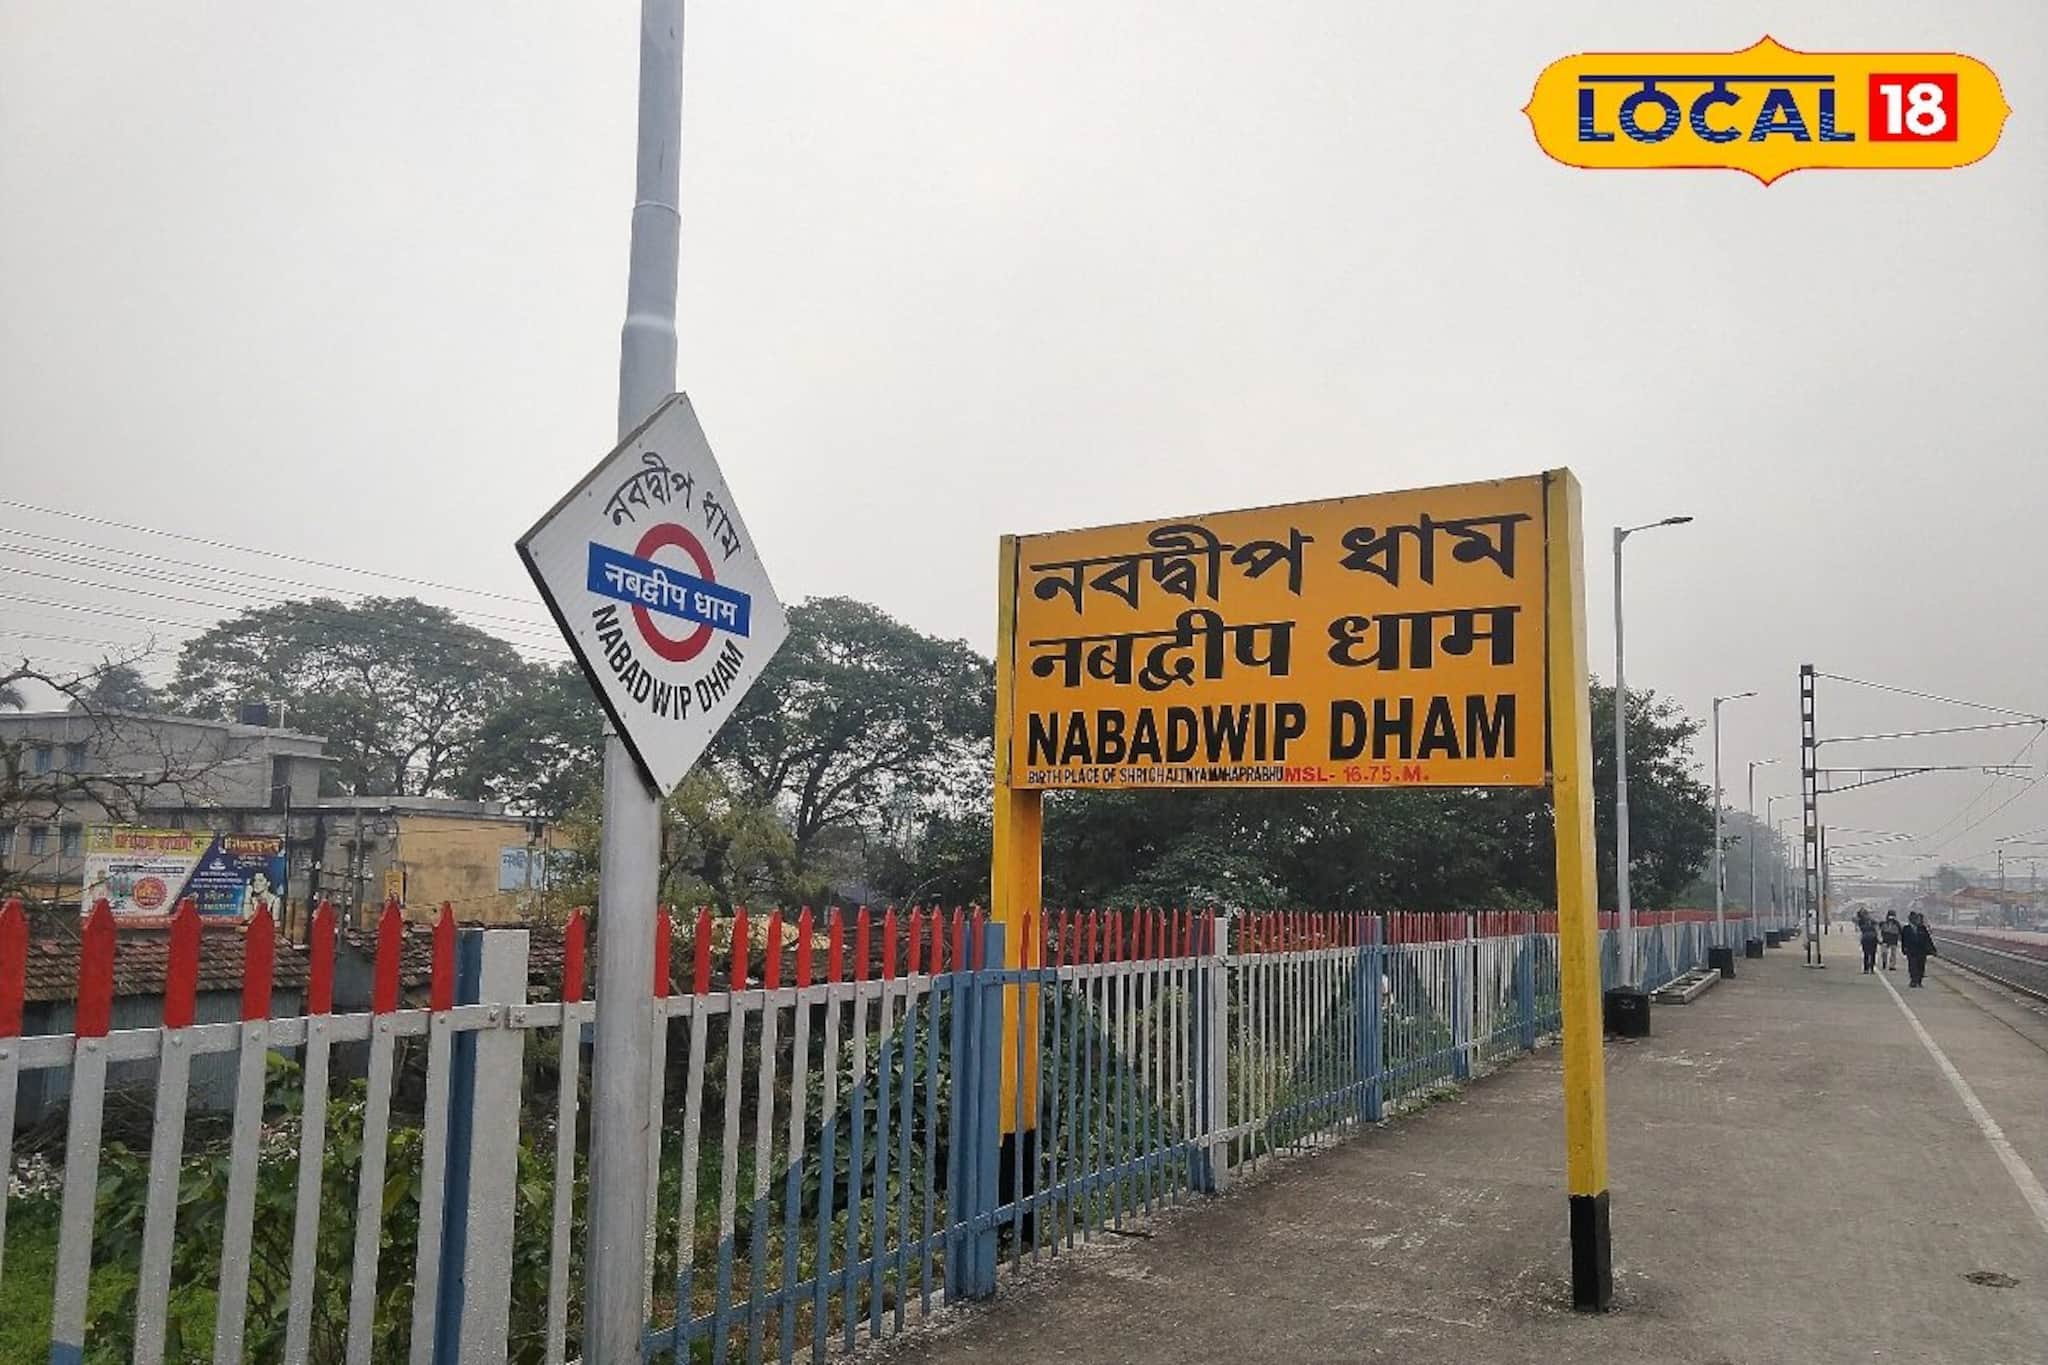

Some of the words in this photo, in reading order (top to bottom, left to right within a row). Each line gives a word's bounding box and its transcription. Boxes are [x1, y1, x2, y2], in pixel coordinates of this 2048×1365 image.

[604, 452, 694, 527] নবদ্বীপ
[703, 490, 741, 561] ধাম
[1029, 523, 1314, 615] নবদ্বীপ
[1340, 512, 1532, 589] ধাম
[695, 591, 737, 625] धाम
[1029, 608, 1297, 692] नबद्वीप
[1327, 605, 1522, 671] धाम
[592, 603, 691, 720] NABADWIP
[697, 639, 745, 713] DHAM
[1027, 702, 1305, 765] NABADWIP
[1328, 693, 1517, 761] DHAM
[1028, 769, 1061, 784] BIRTH
[1064, 768, 1099, 783] PLACE
[1102, 768, 1117, 783] OF
